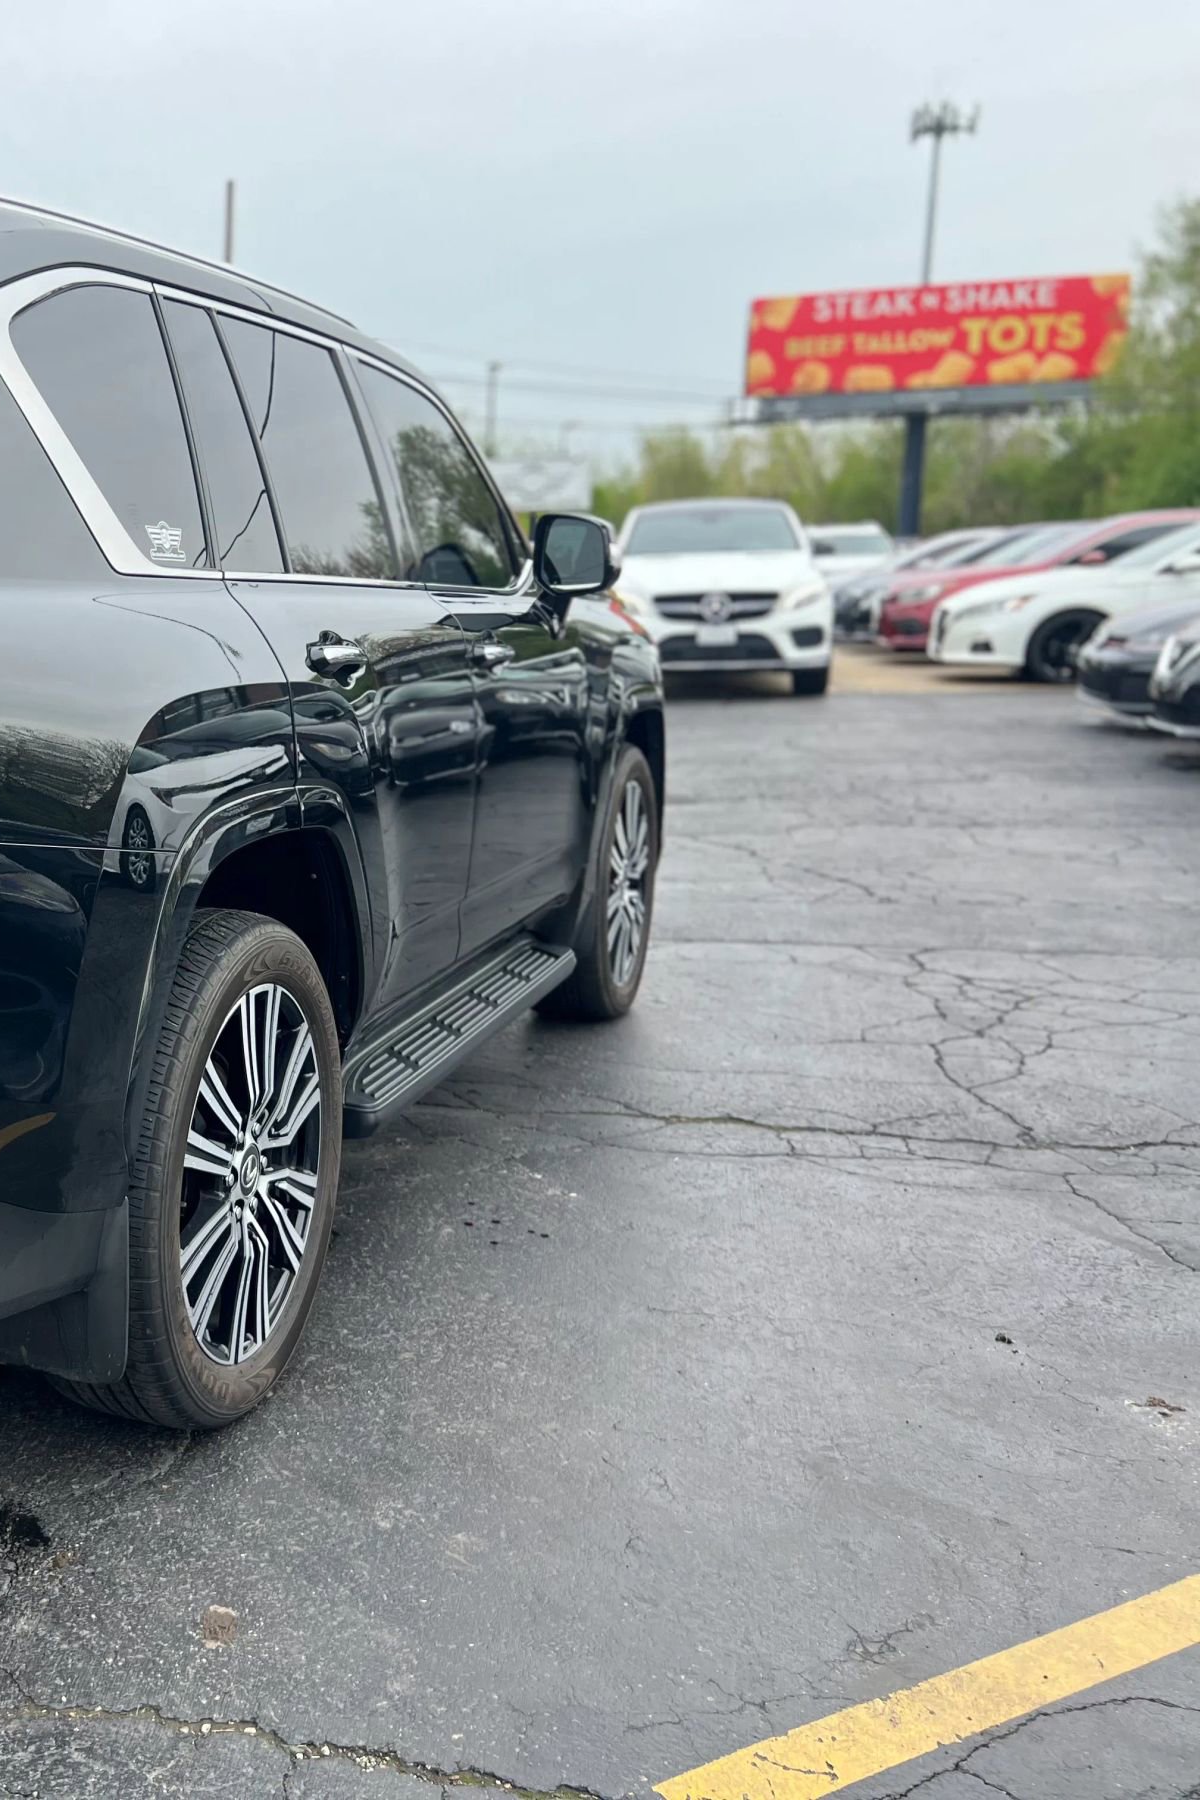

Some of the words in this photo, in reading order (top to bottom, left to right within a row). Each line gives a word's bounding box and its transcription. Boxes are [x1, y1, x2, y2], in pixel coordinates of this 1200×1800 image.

[812, 290, 917, 323] STEAK
[944, 281, 1058, 314] SHAKE
[960, 311, 1086, 355] TOTS
